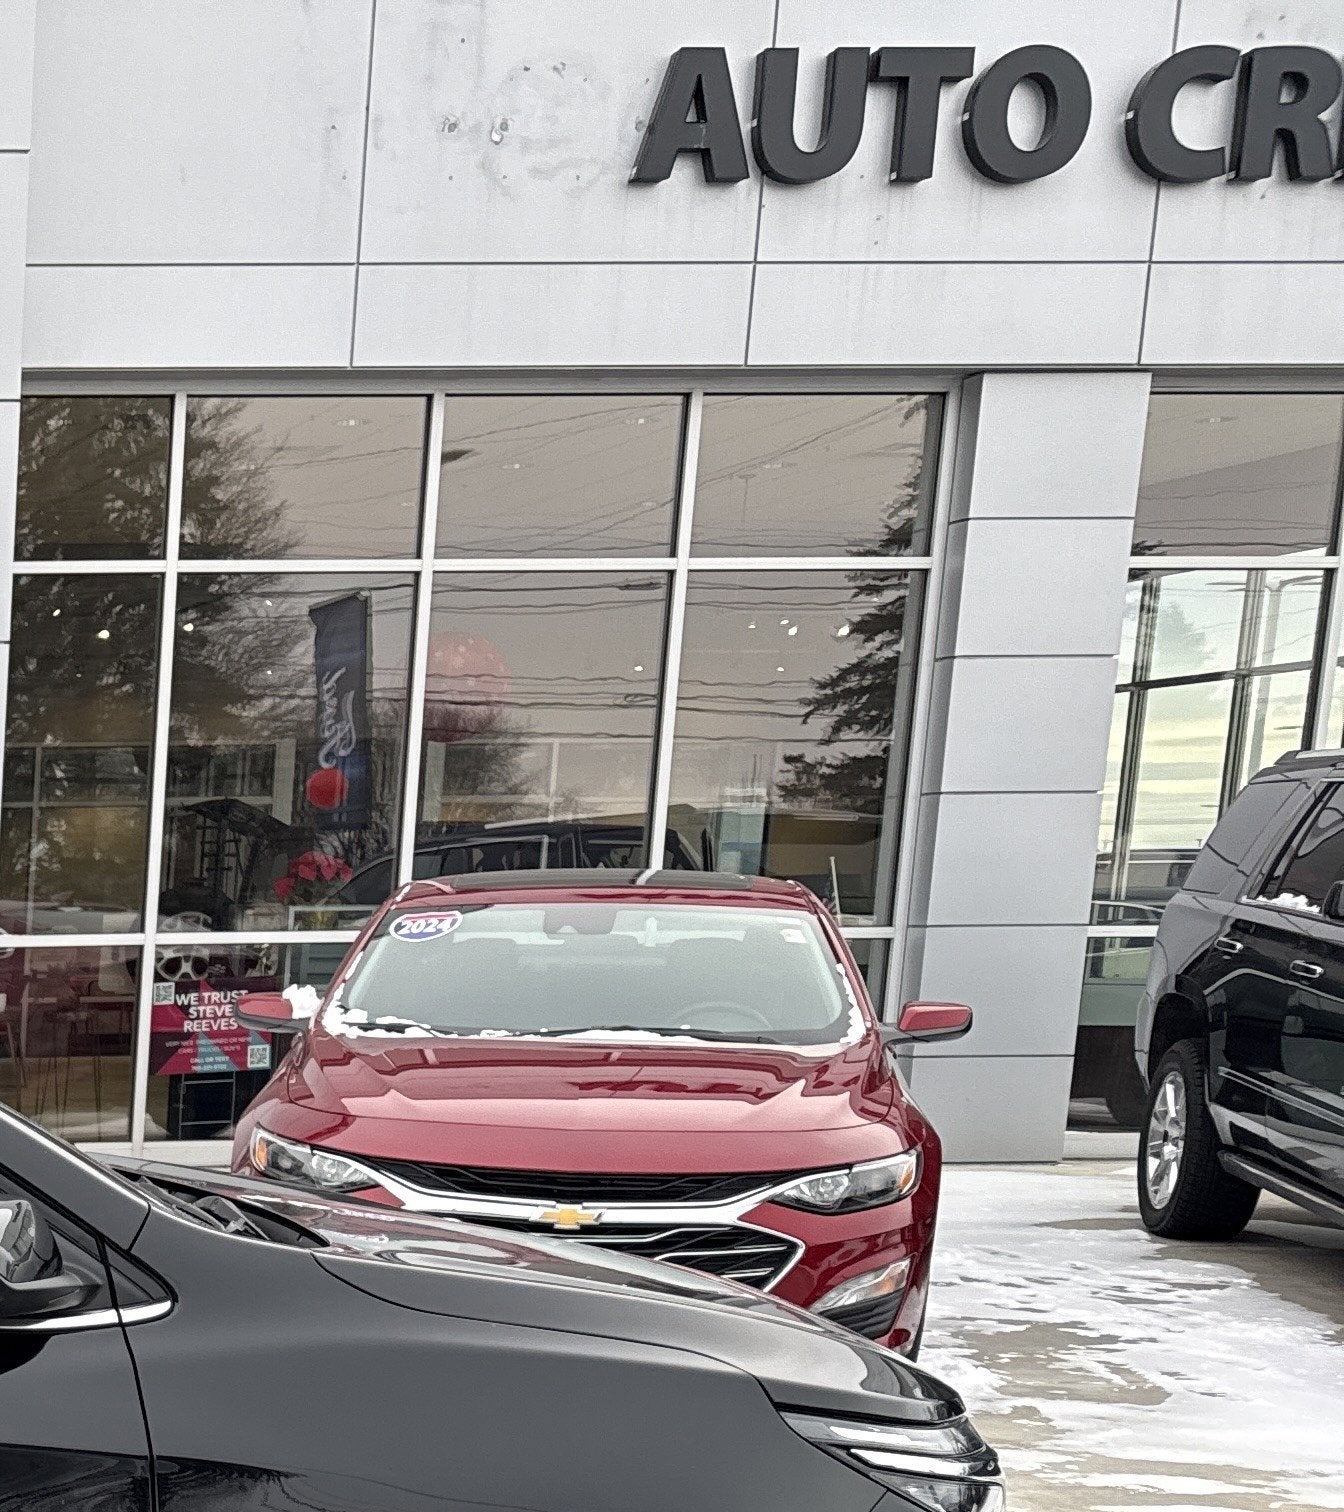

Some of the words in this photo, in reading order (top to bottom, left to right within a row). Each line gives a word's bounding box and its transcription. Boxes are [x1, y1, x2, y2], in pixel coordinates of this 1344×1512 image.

[628, 43, 1092, 185] AUTO
[1125, 43, 1344, 184] CR
[397, 917, 452, 934] 2024
[175, 993, 199, 1006] WE
[188, 1004, 234, 1019] STEVE
[183, 1018, 239, 1033] REEVES
